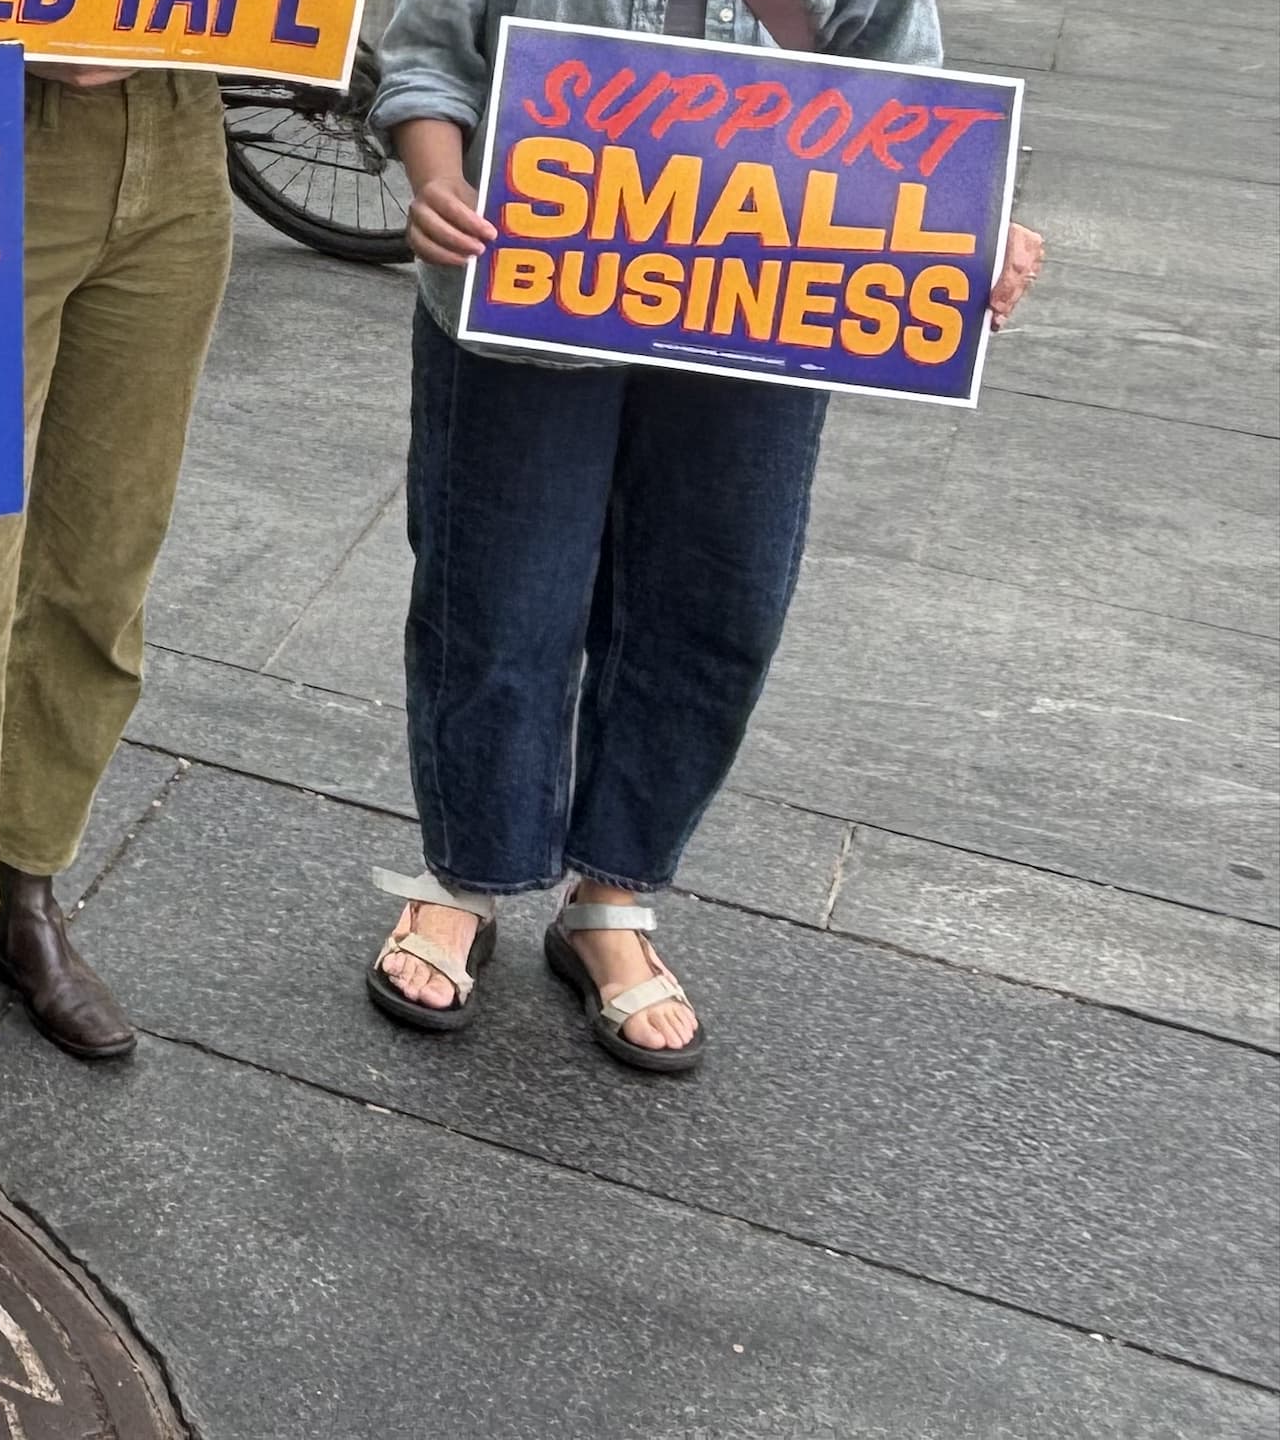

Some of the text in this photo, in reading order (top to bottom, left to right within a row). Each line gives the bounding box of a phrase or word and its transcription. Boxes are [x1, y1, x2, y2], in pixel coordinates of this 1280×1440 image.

[524, 61, 1006, 177] SUPPORT
[501, 137, 977, 257] SMALL
[488, 248, 970, 365] BUSINESS
